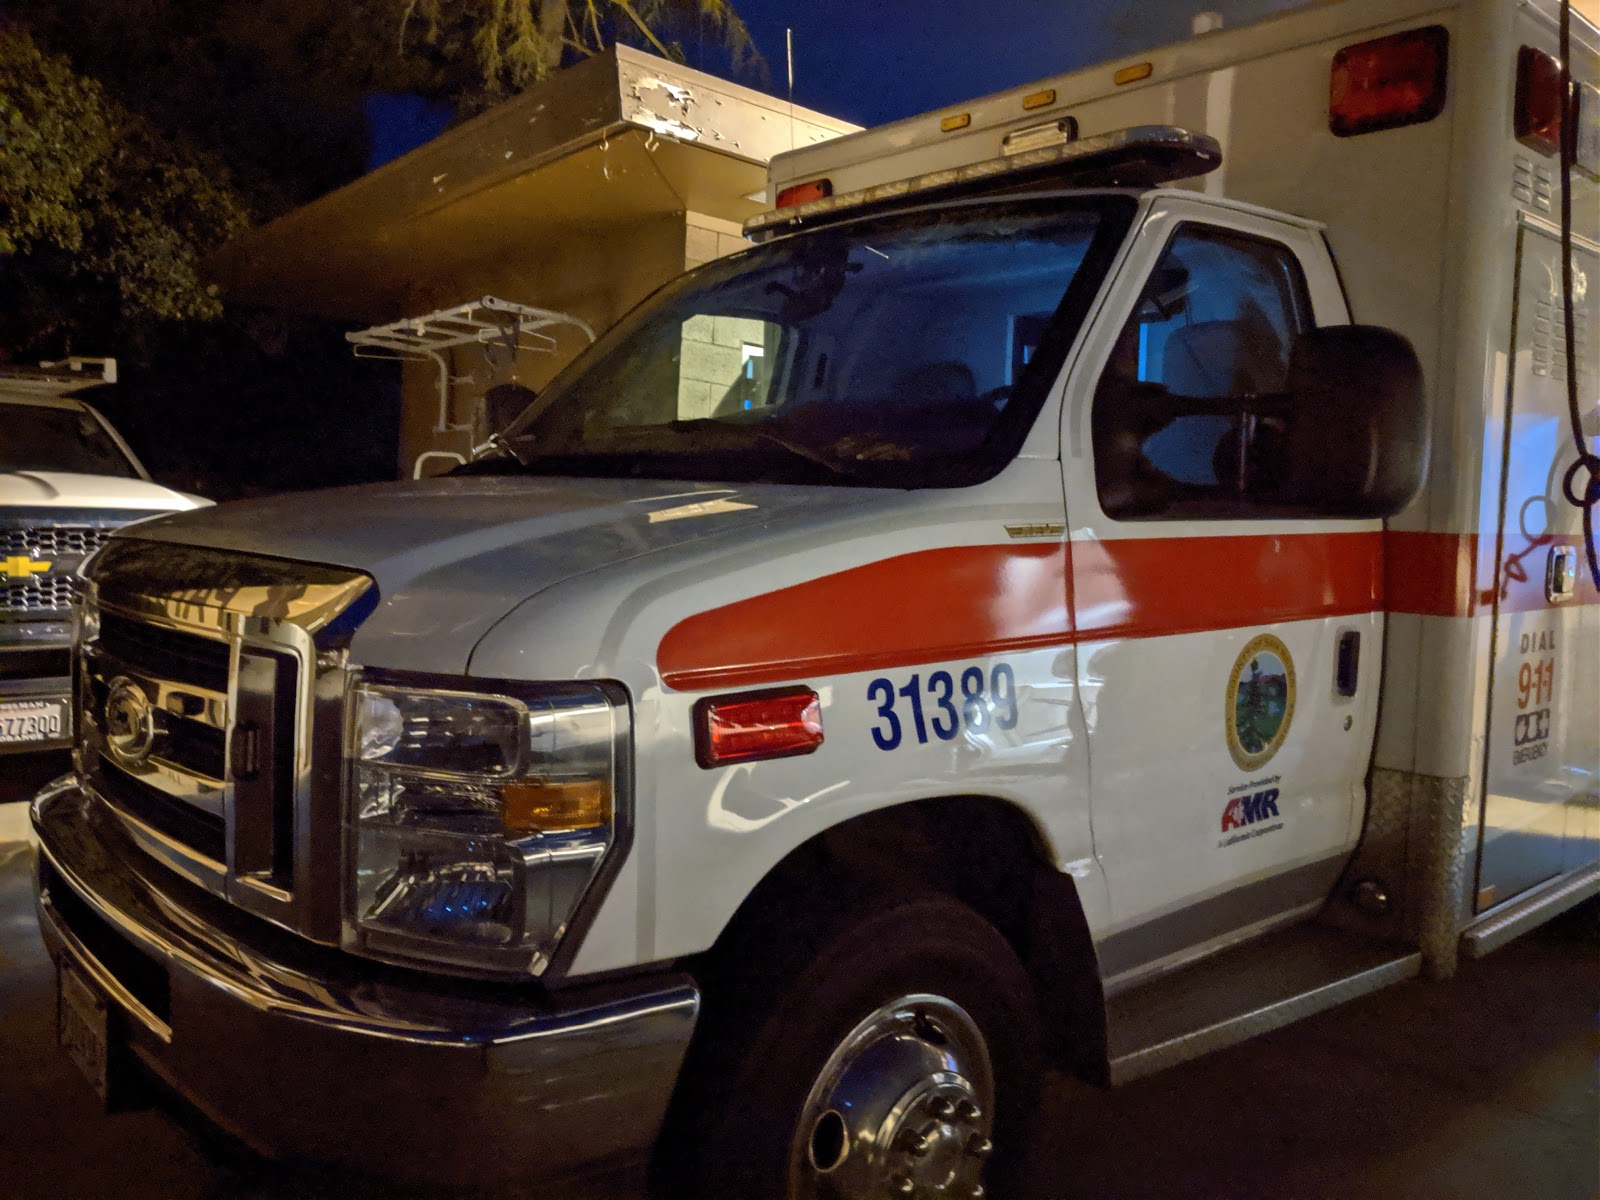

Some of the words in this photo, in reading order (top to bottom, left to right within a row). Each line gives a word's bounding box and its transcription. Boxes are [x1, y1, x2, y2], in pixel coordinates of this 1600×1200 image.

[1520, 630, 1555, 654] DIAL
[867, 663, 1018, 751] 31389
[1221, 787, 1280, 833] AMR
